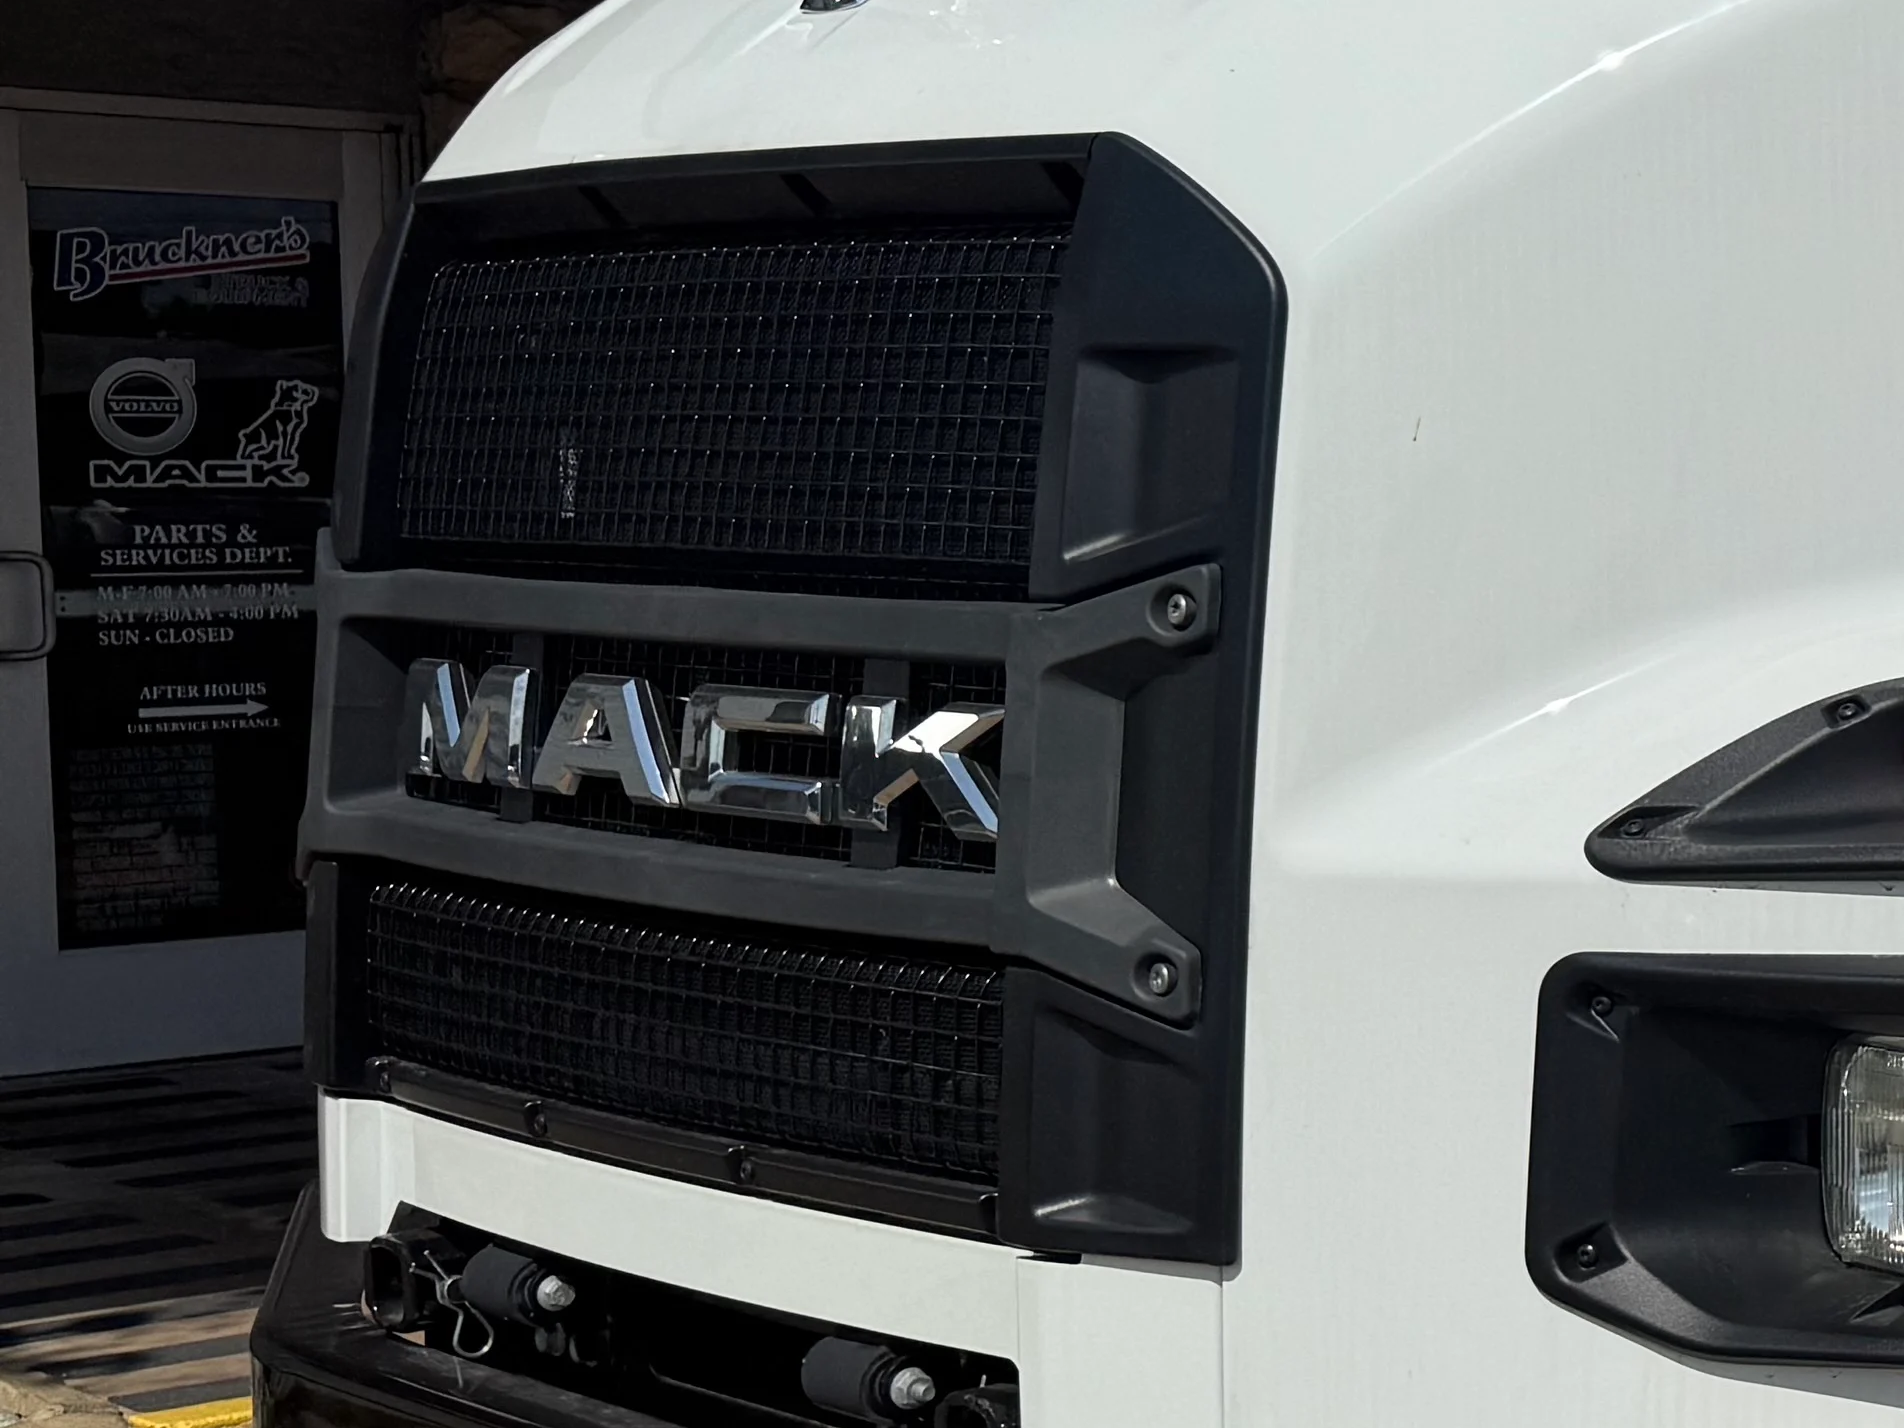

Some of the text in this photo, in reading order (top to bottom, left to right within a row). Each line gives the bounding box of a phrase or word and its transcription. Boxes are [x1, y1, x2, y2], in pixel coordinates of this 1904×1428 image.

[54, 216, 309, 301] Bruckner's
[107, 400, 181, 413] VOLVO
[90, 459, 300, 489] MACK
[134, 523, 258, 545] PARTS &
[101, 546, 292, 567] SERVICES DEPT.
[176, 584, 207, 599] AM
[261, 582, 290, 598] PM
[97, 608, 136, 624] SAT
[269, 604, 299, 620] PM
[98, 629, 140, 646] SUN
[155, 627, 235, 644] CLOSED
[140, 682, 267, 700] AFTER HOURS
[403, 657, 1006, 841] MACK
